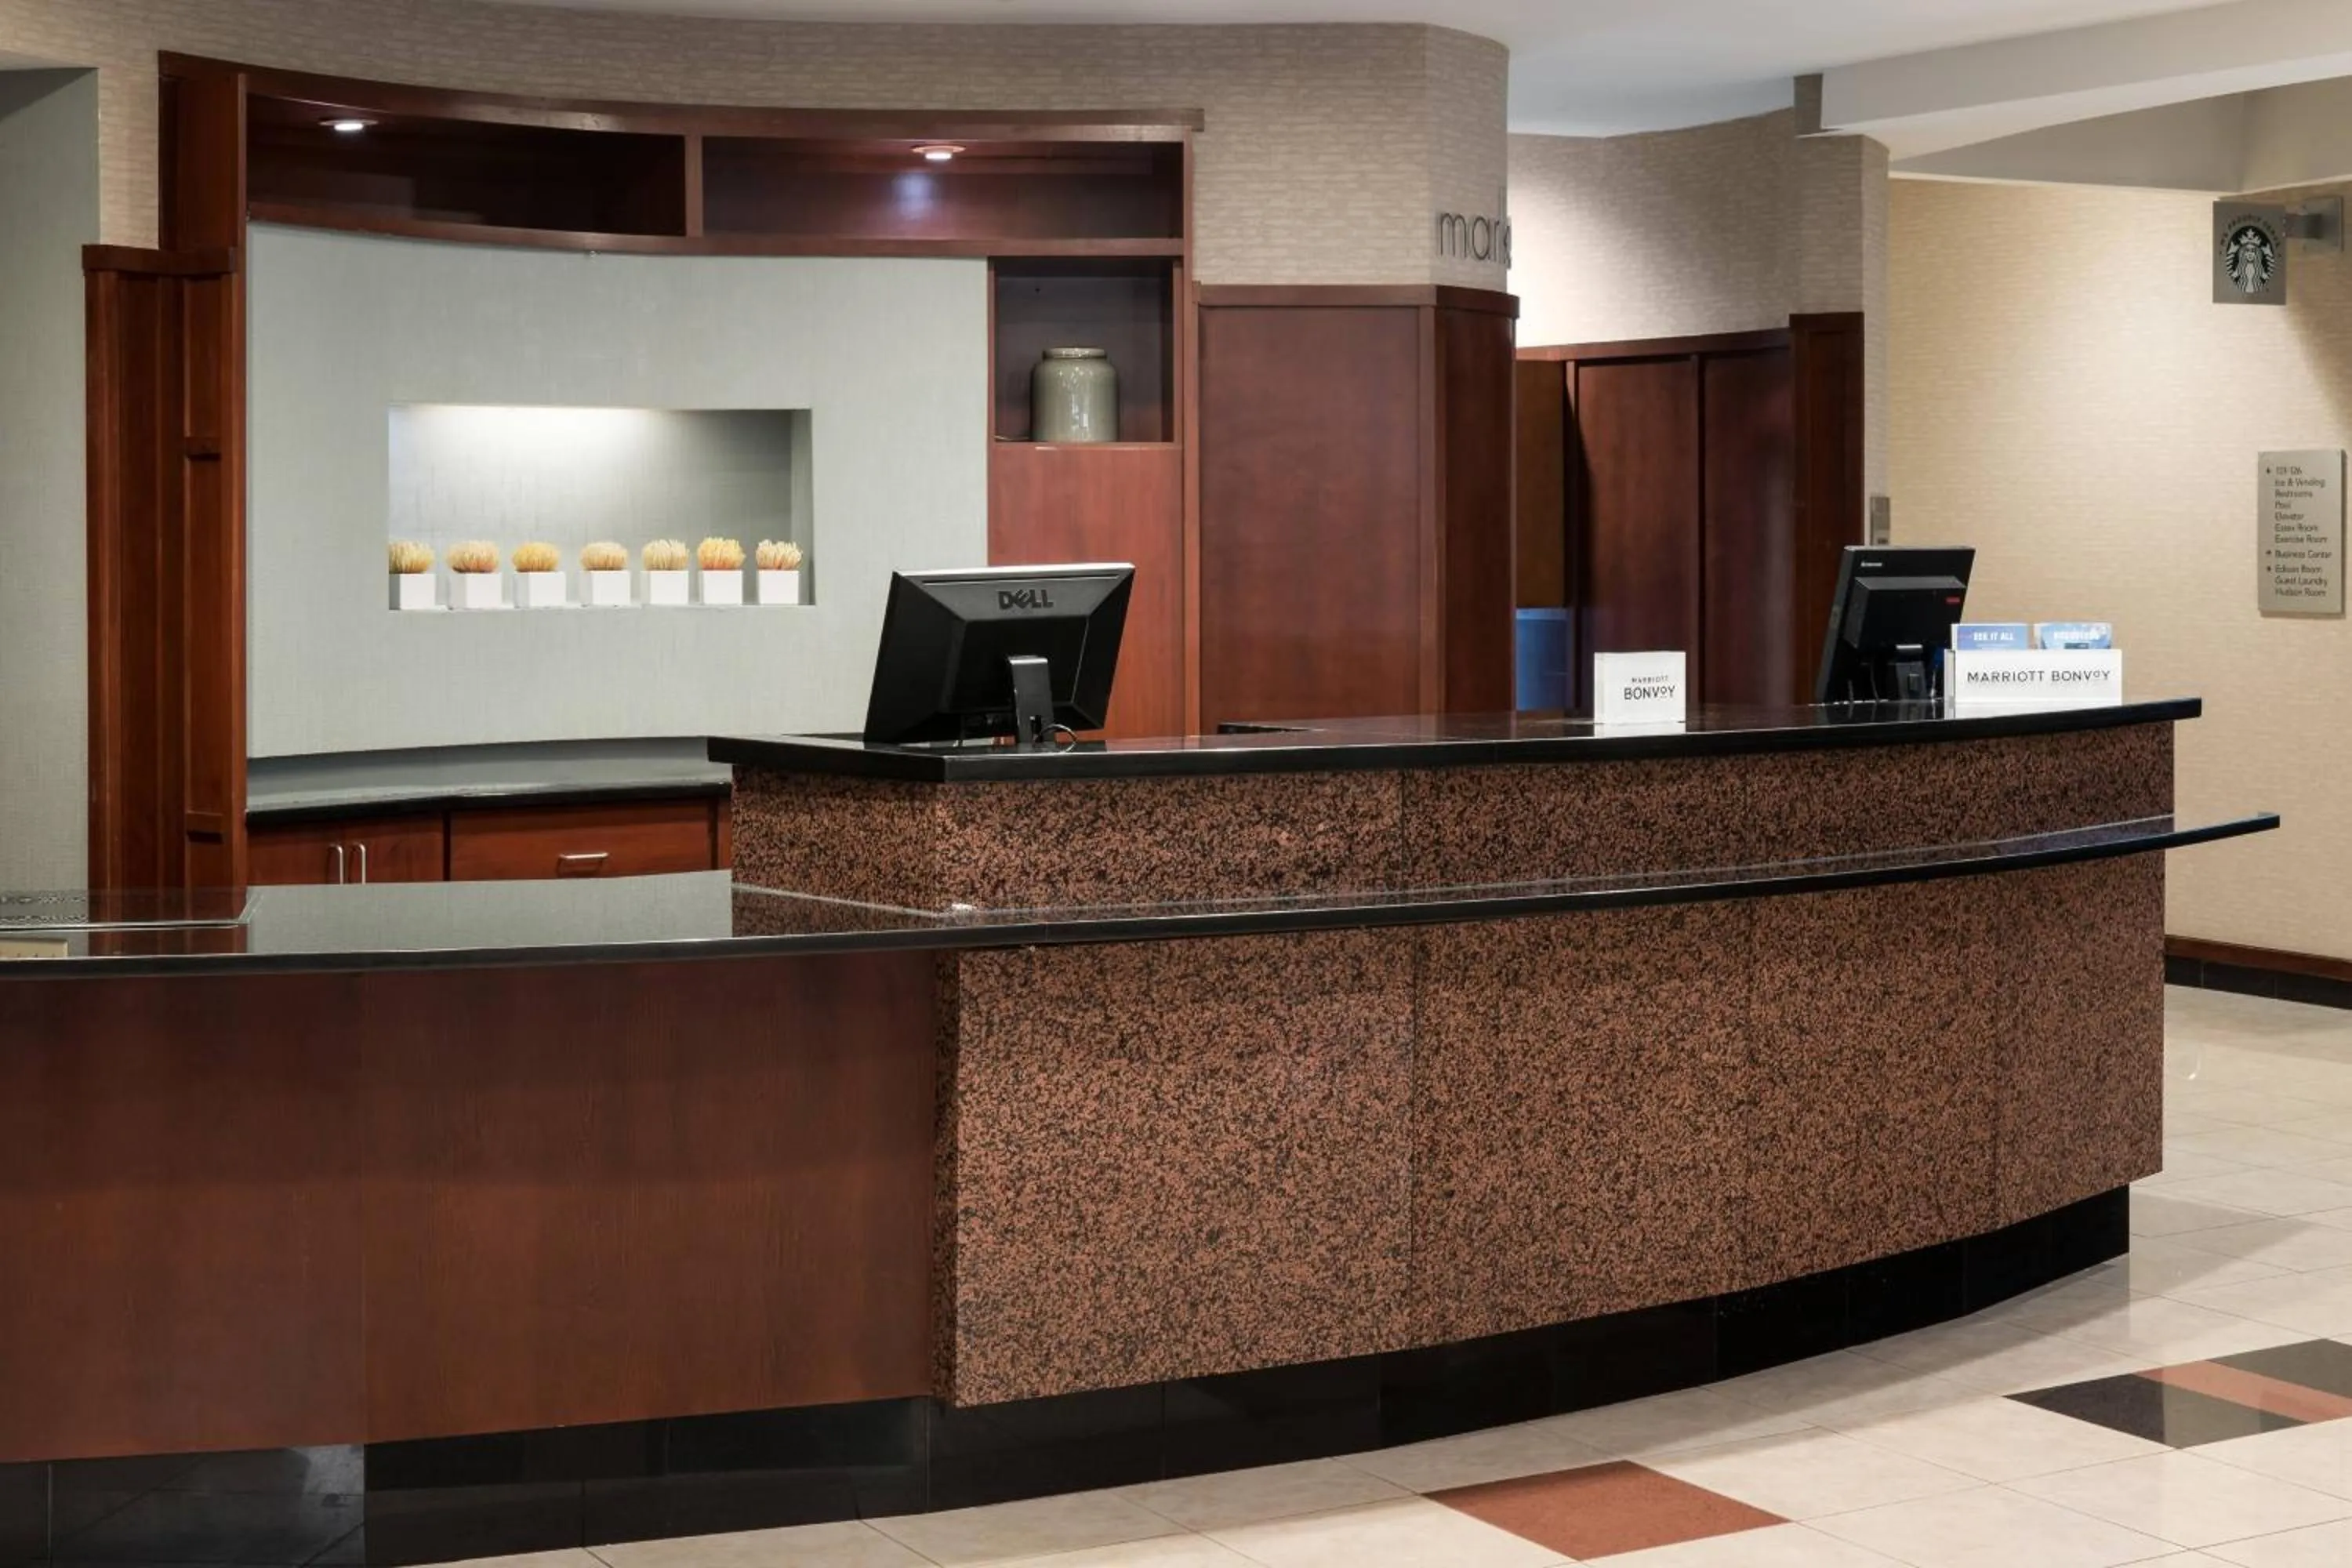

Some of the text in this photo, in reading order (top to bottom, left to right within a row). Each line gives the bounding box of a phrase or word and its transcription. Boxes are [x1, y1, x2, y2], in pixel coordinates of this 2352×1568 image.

[998, 588, 1054, 610] DELL
[1632, 675, 1668, 684] MARRIOTT
[1966, 670, 2045, 683] MARRIOTT
